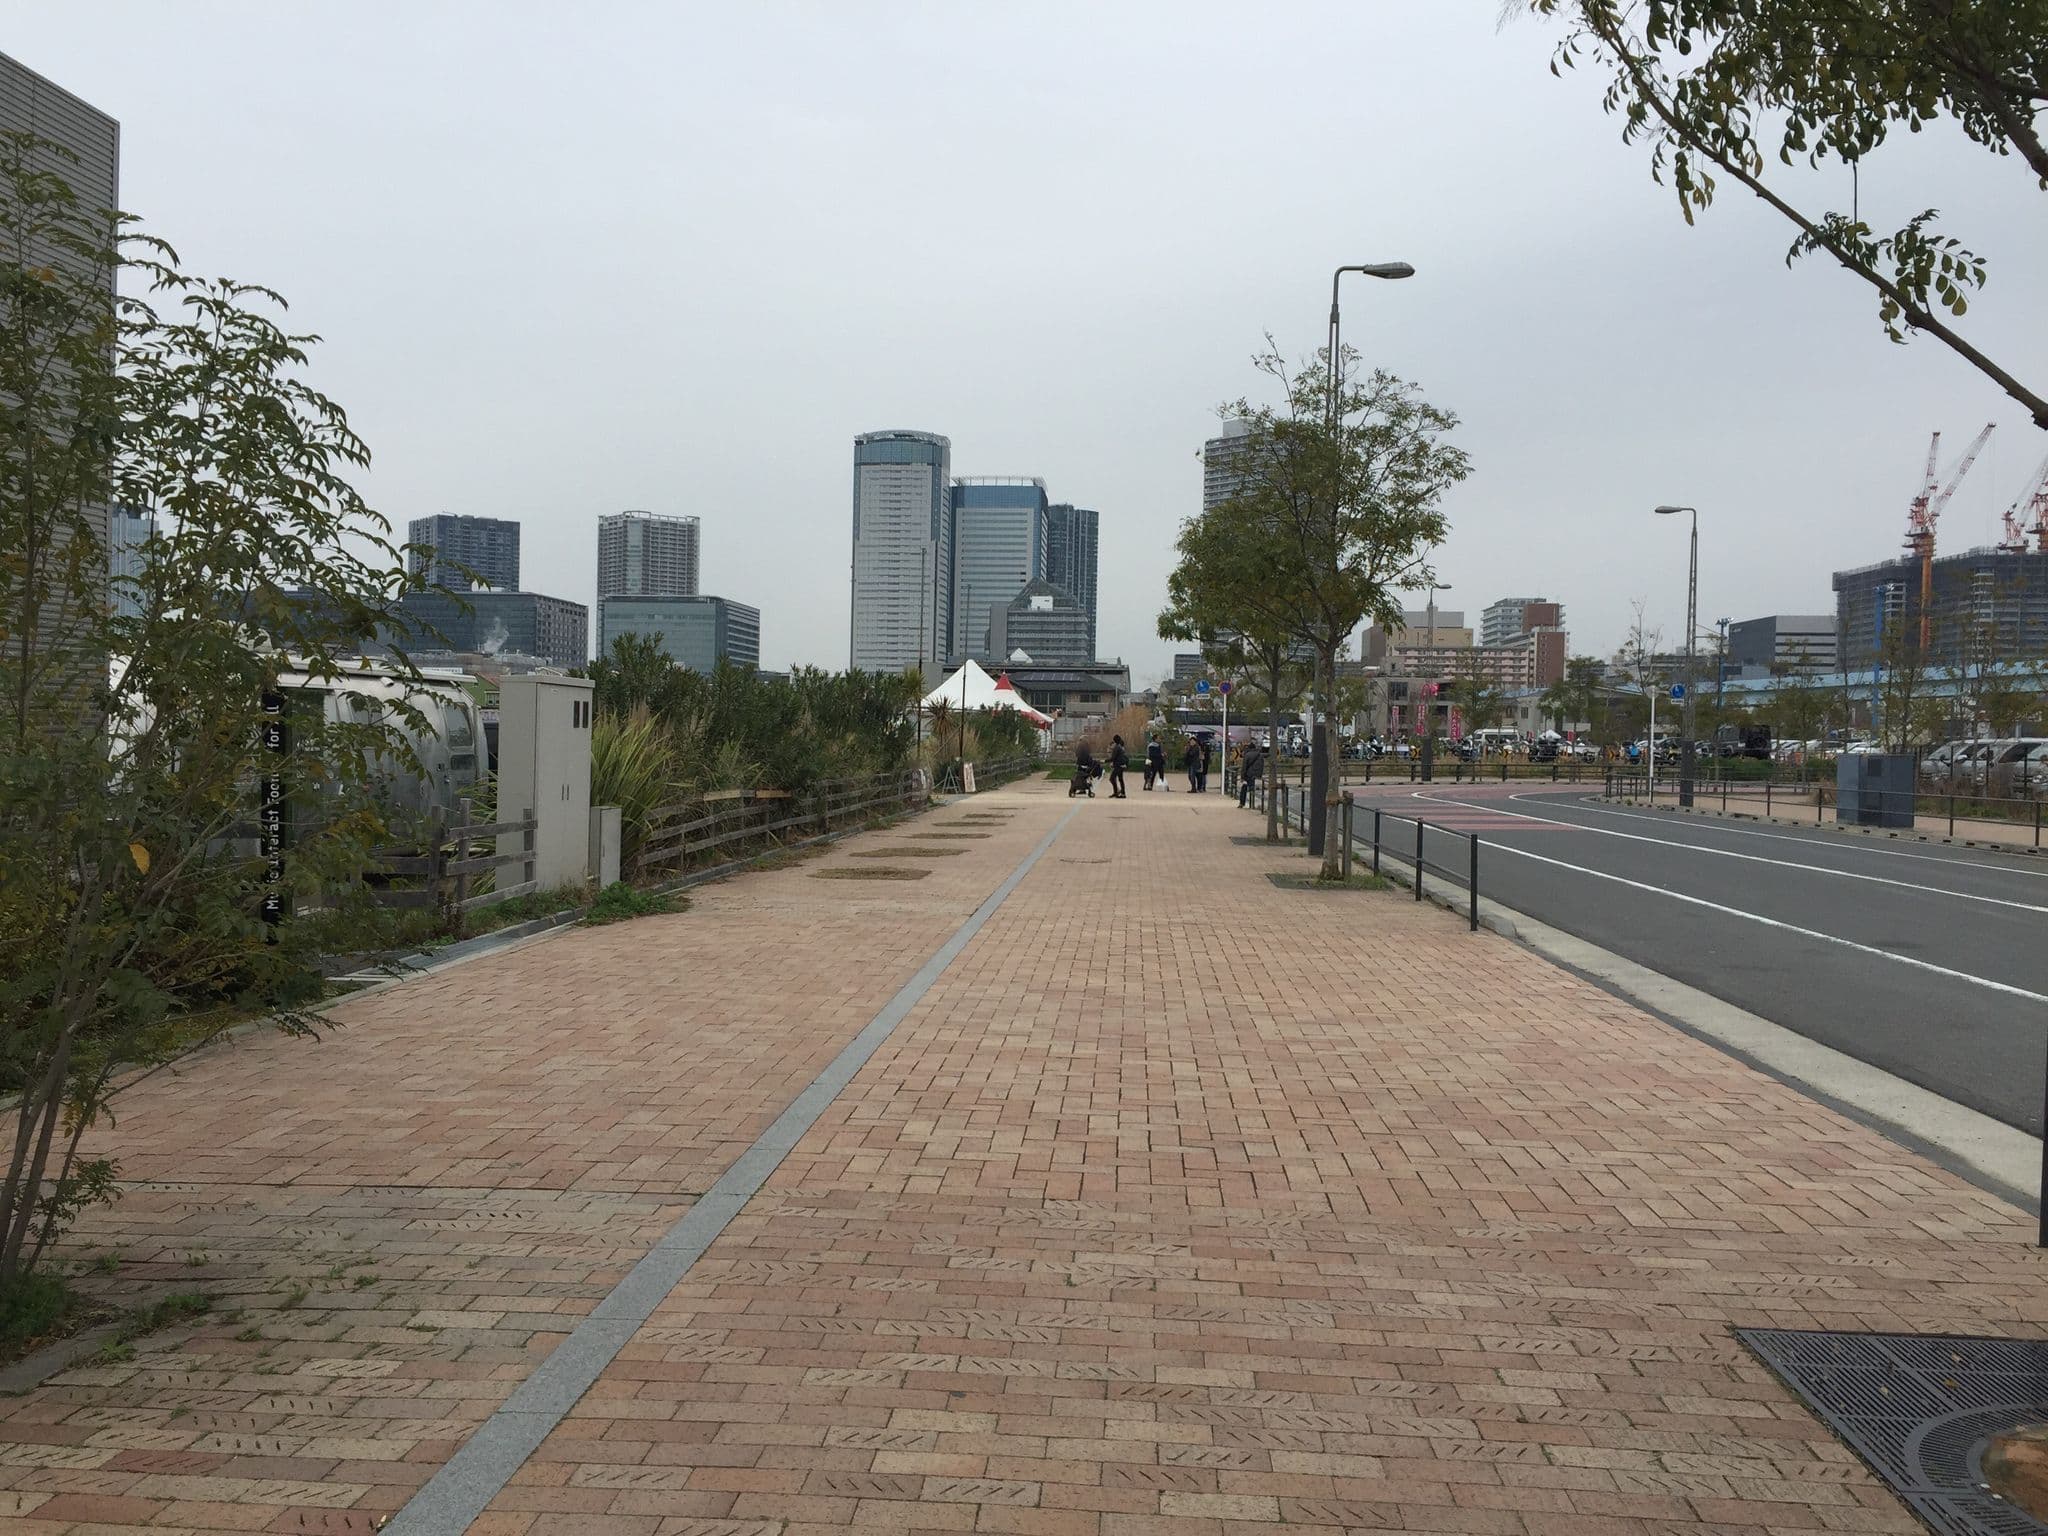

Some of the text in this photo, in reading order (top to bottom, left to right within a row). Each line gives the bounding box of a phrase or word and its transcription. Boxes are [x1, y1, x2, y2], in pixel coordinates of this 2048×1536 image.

[265, 705, 280, 726] ll
[267, 728, 280, 748] for
[266, 872, 280, 910] Muic
